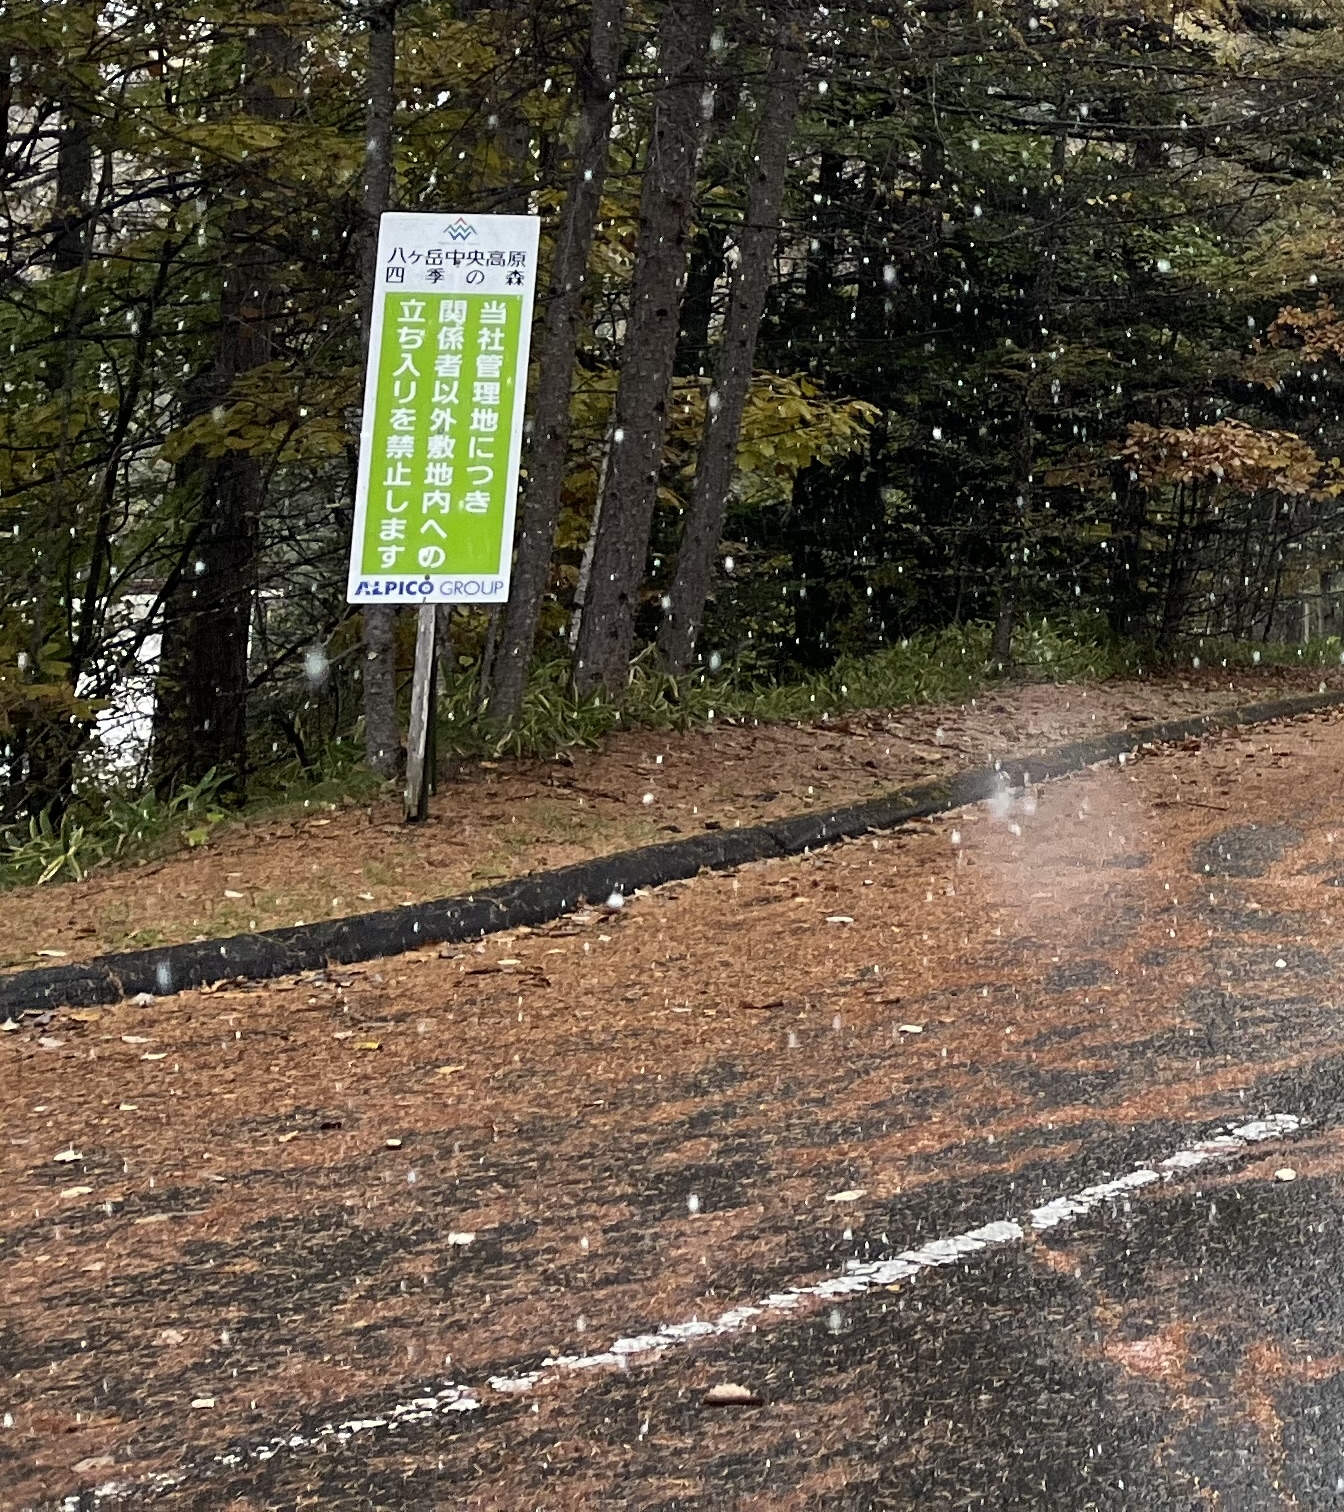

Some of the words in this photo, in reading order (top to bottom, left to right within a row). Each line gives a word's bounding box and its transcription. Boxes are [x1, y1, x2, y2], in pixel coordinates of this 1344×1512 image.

[385, 266, 525, 286] 四季の森
[387, 247, 527, 267] 八ヶ岳中央高原
[377, 298, 427, 569] 立ち入りを禁止します
[417, 299, 468, 569] 関係者以外敷地内への
[463, 299, 508, 515] 当社管理地につき
[355, 580, 434, 596] ALPICO
[440, 580, 504, 596] GROUP
